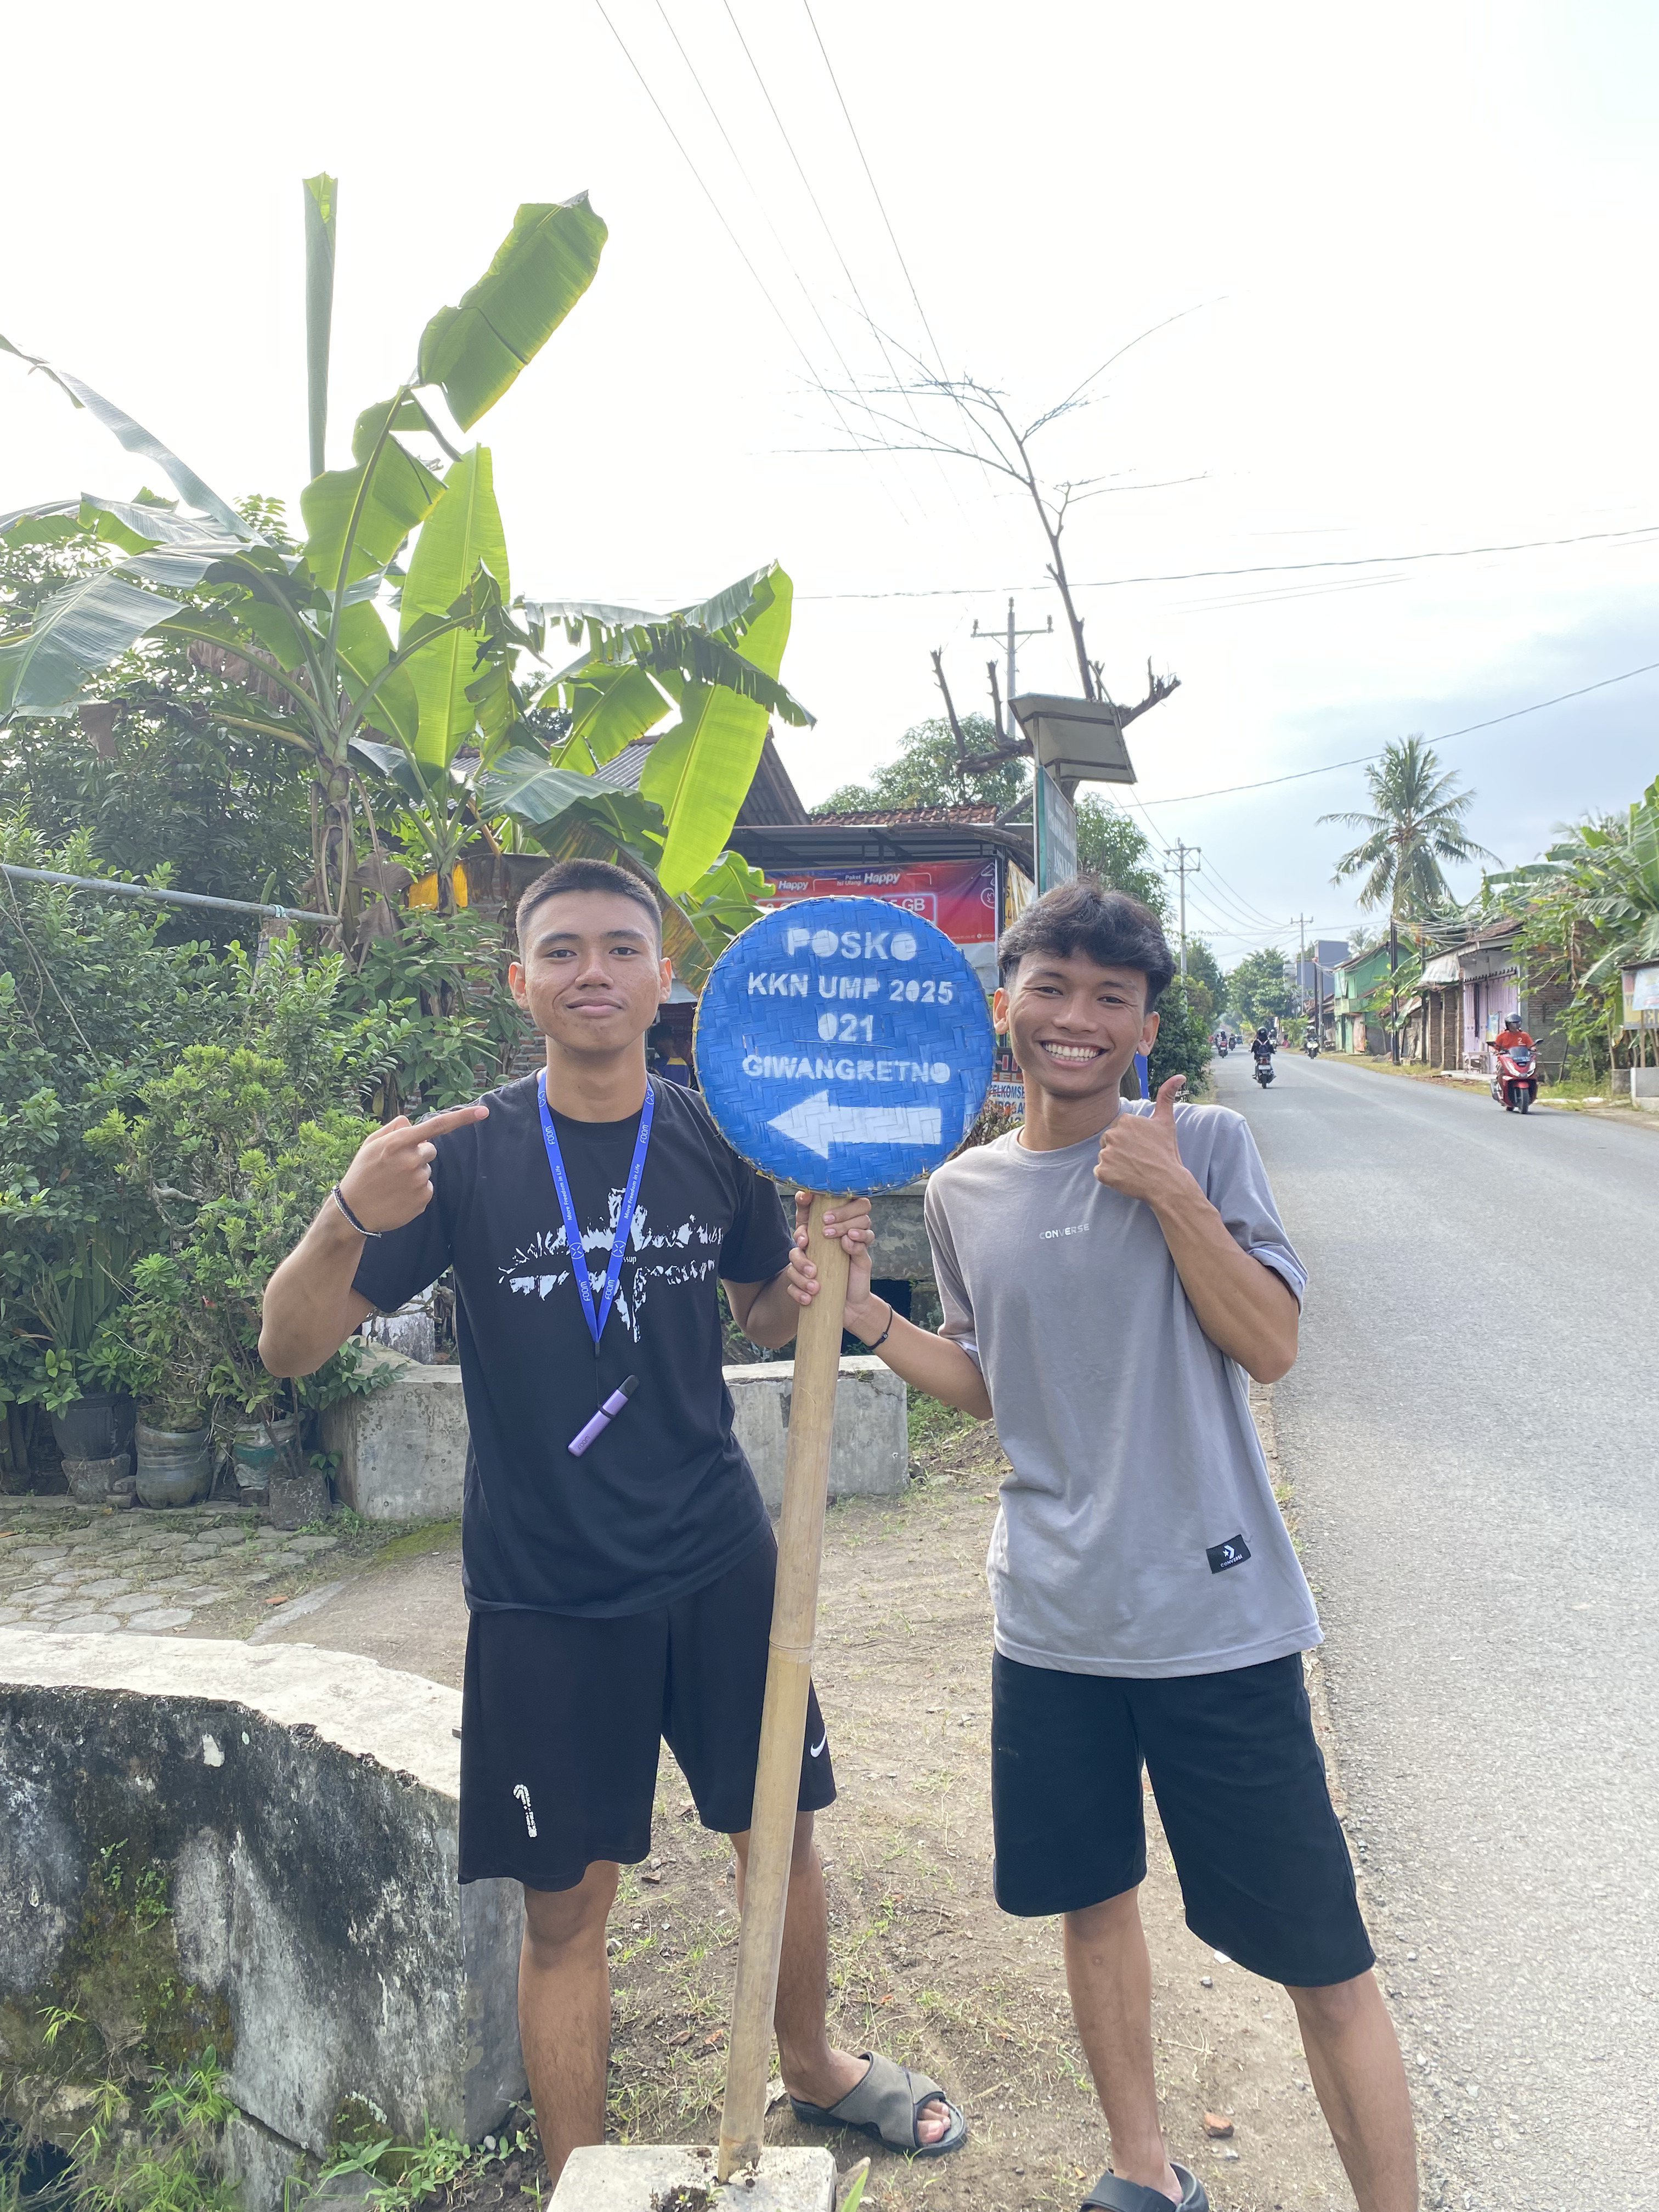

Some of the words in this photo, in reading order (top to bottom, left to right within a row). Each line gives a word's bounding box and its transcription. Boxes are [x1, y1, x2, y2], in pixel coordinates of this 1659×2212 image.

[778, 881, 809, 890] Happy
[864, 872, 900, 885] Happy
[902, 898, 926, 911] GB
[787, 928, 917, 962] POSKO
[748, 972, 808, 997] KKN
[819, 976, 881, 1000] UMP
[890, 980, 953, 1005] 2025
[817, 1012, 874, 1042] 021
[742, 1054, 950, 1084] GIWANGRETNO
[545, 1125, 556, 1145] FOOM
[640, 1124, 649, 1144] FOOM
[560, 1182, 569, 1205] Freedom
[628, 1181, 637, 1204] Freedom
[1039, 1223, 1090, 1239] CONVERSE
[623, 1256, 637, 1265] ssup
[580, 1281, 591, 1302] FOOM
[605, 1279, 615, 1300] FOOM
[1220, 1554, 1243, 1567] CONVERSE
